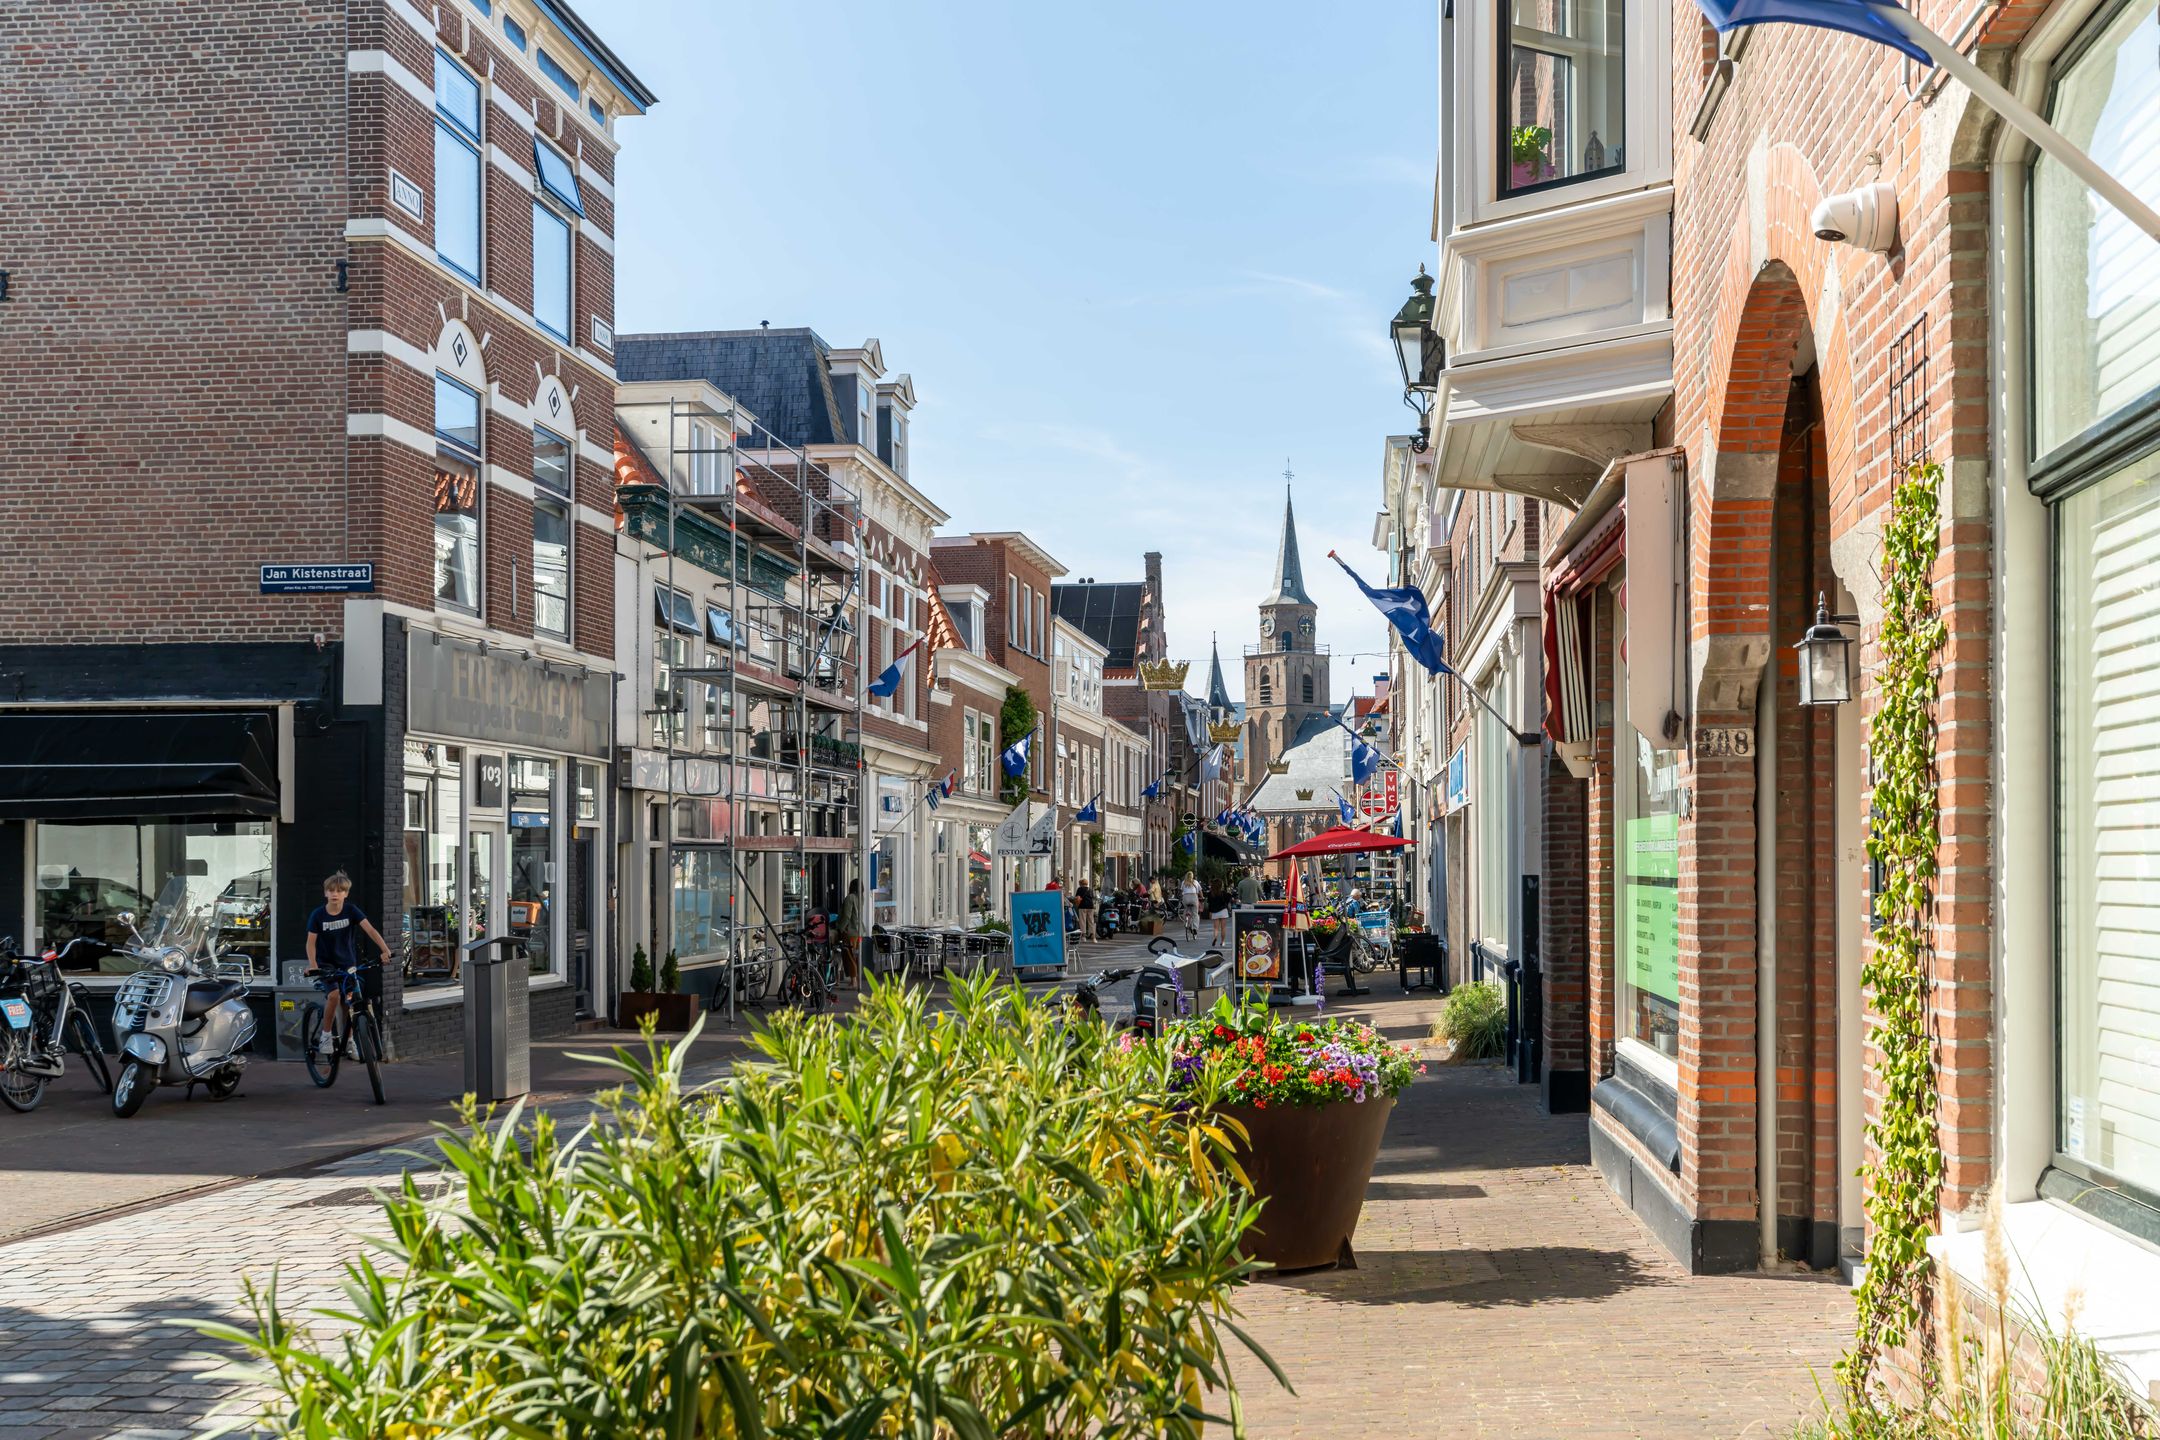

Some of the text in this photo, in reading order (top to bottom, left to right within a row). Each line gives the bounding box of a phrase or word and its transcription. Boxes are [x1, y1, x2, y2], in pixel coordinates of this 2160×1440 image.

[395, 183, 419, 211] ANNO
[265, 567, 367, 579] Jan Kistenstraat
[481, 764, 502, 787] 103
[1387, 775, 1397, 812] YMCA
